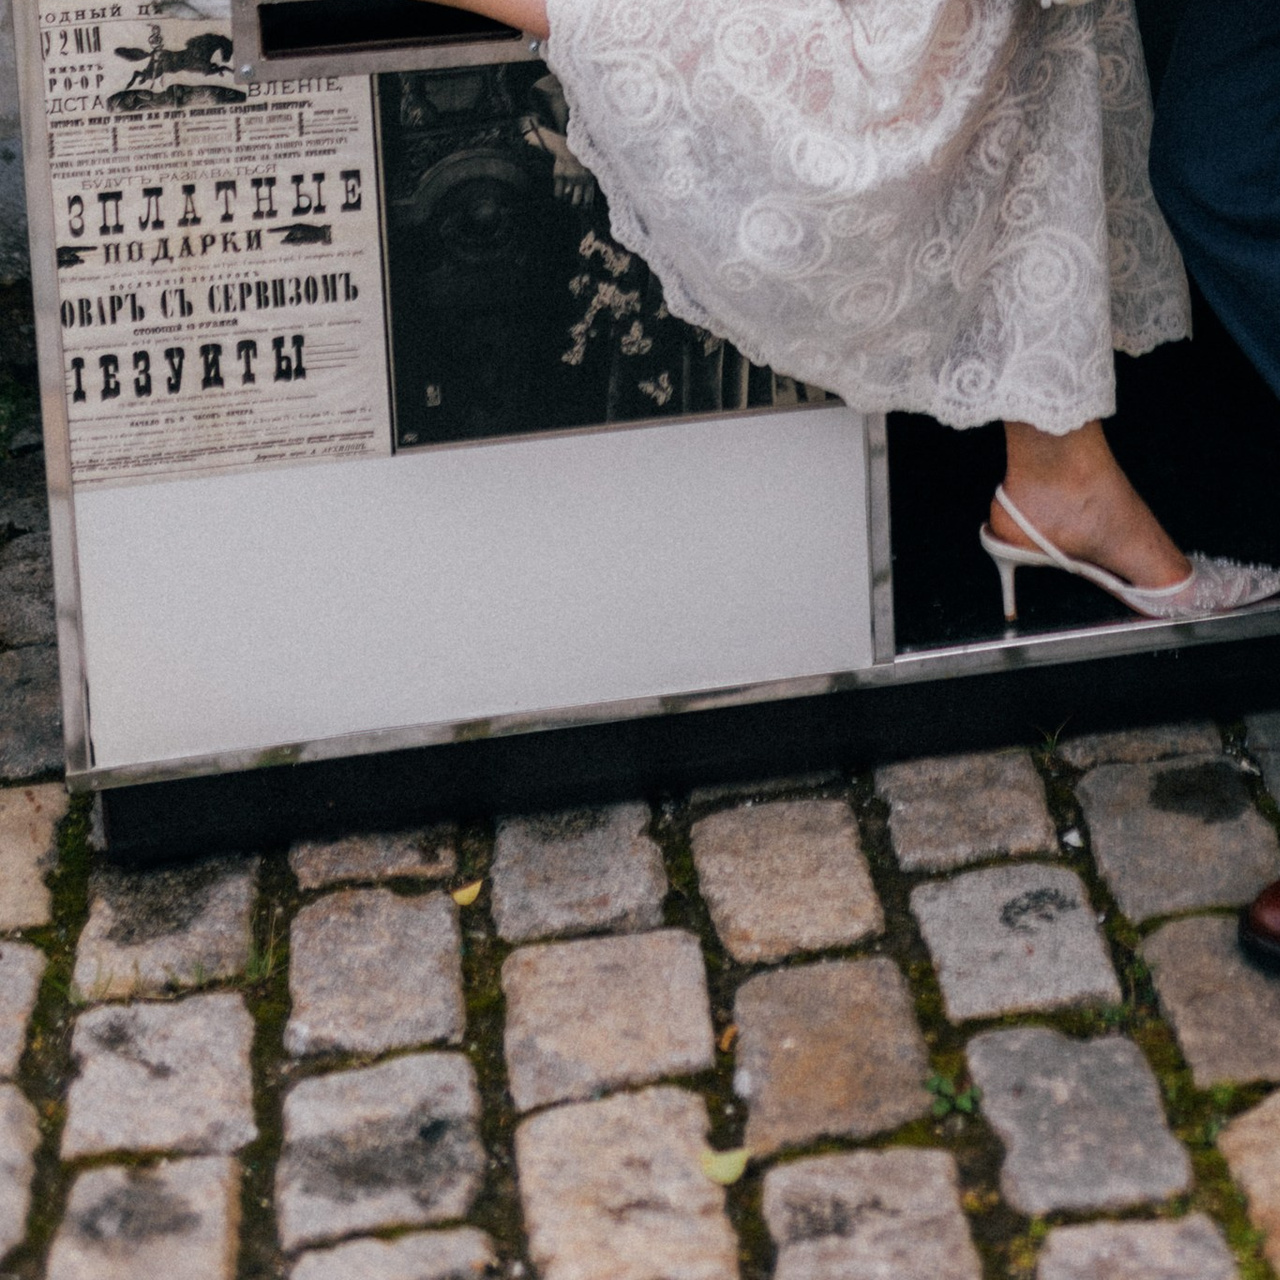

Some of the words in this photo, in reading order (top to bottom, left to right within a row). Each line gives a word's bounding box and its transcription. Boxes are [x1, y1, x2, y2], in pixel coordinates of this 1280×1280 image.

[39, 3, 122, 24] ОДНЫЙ
[103, 228, 263, 266] ПОДАРКИ
[207, 271, 359, 314] СЕРВИЗОМЪ
